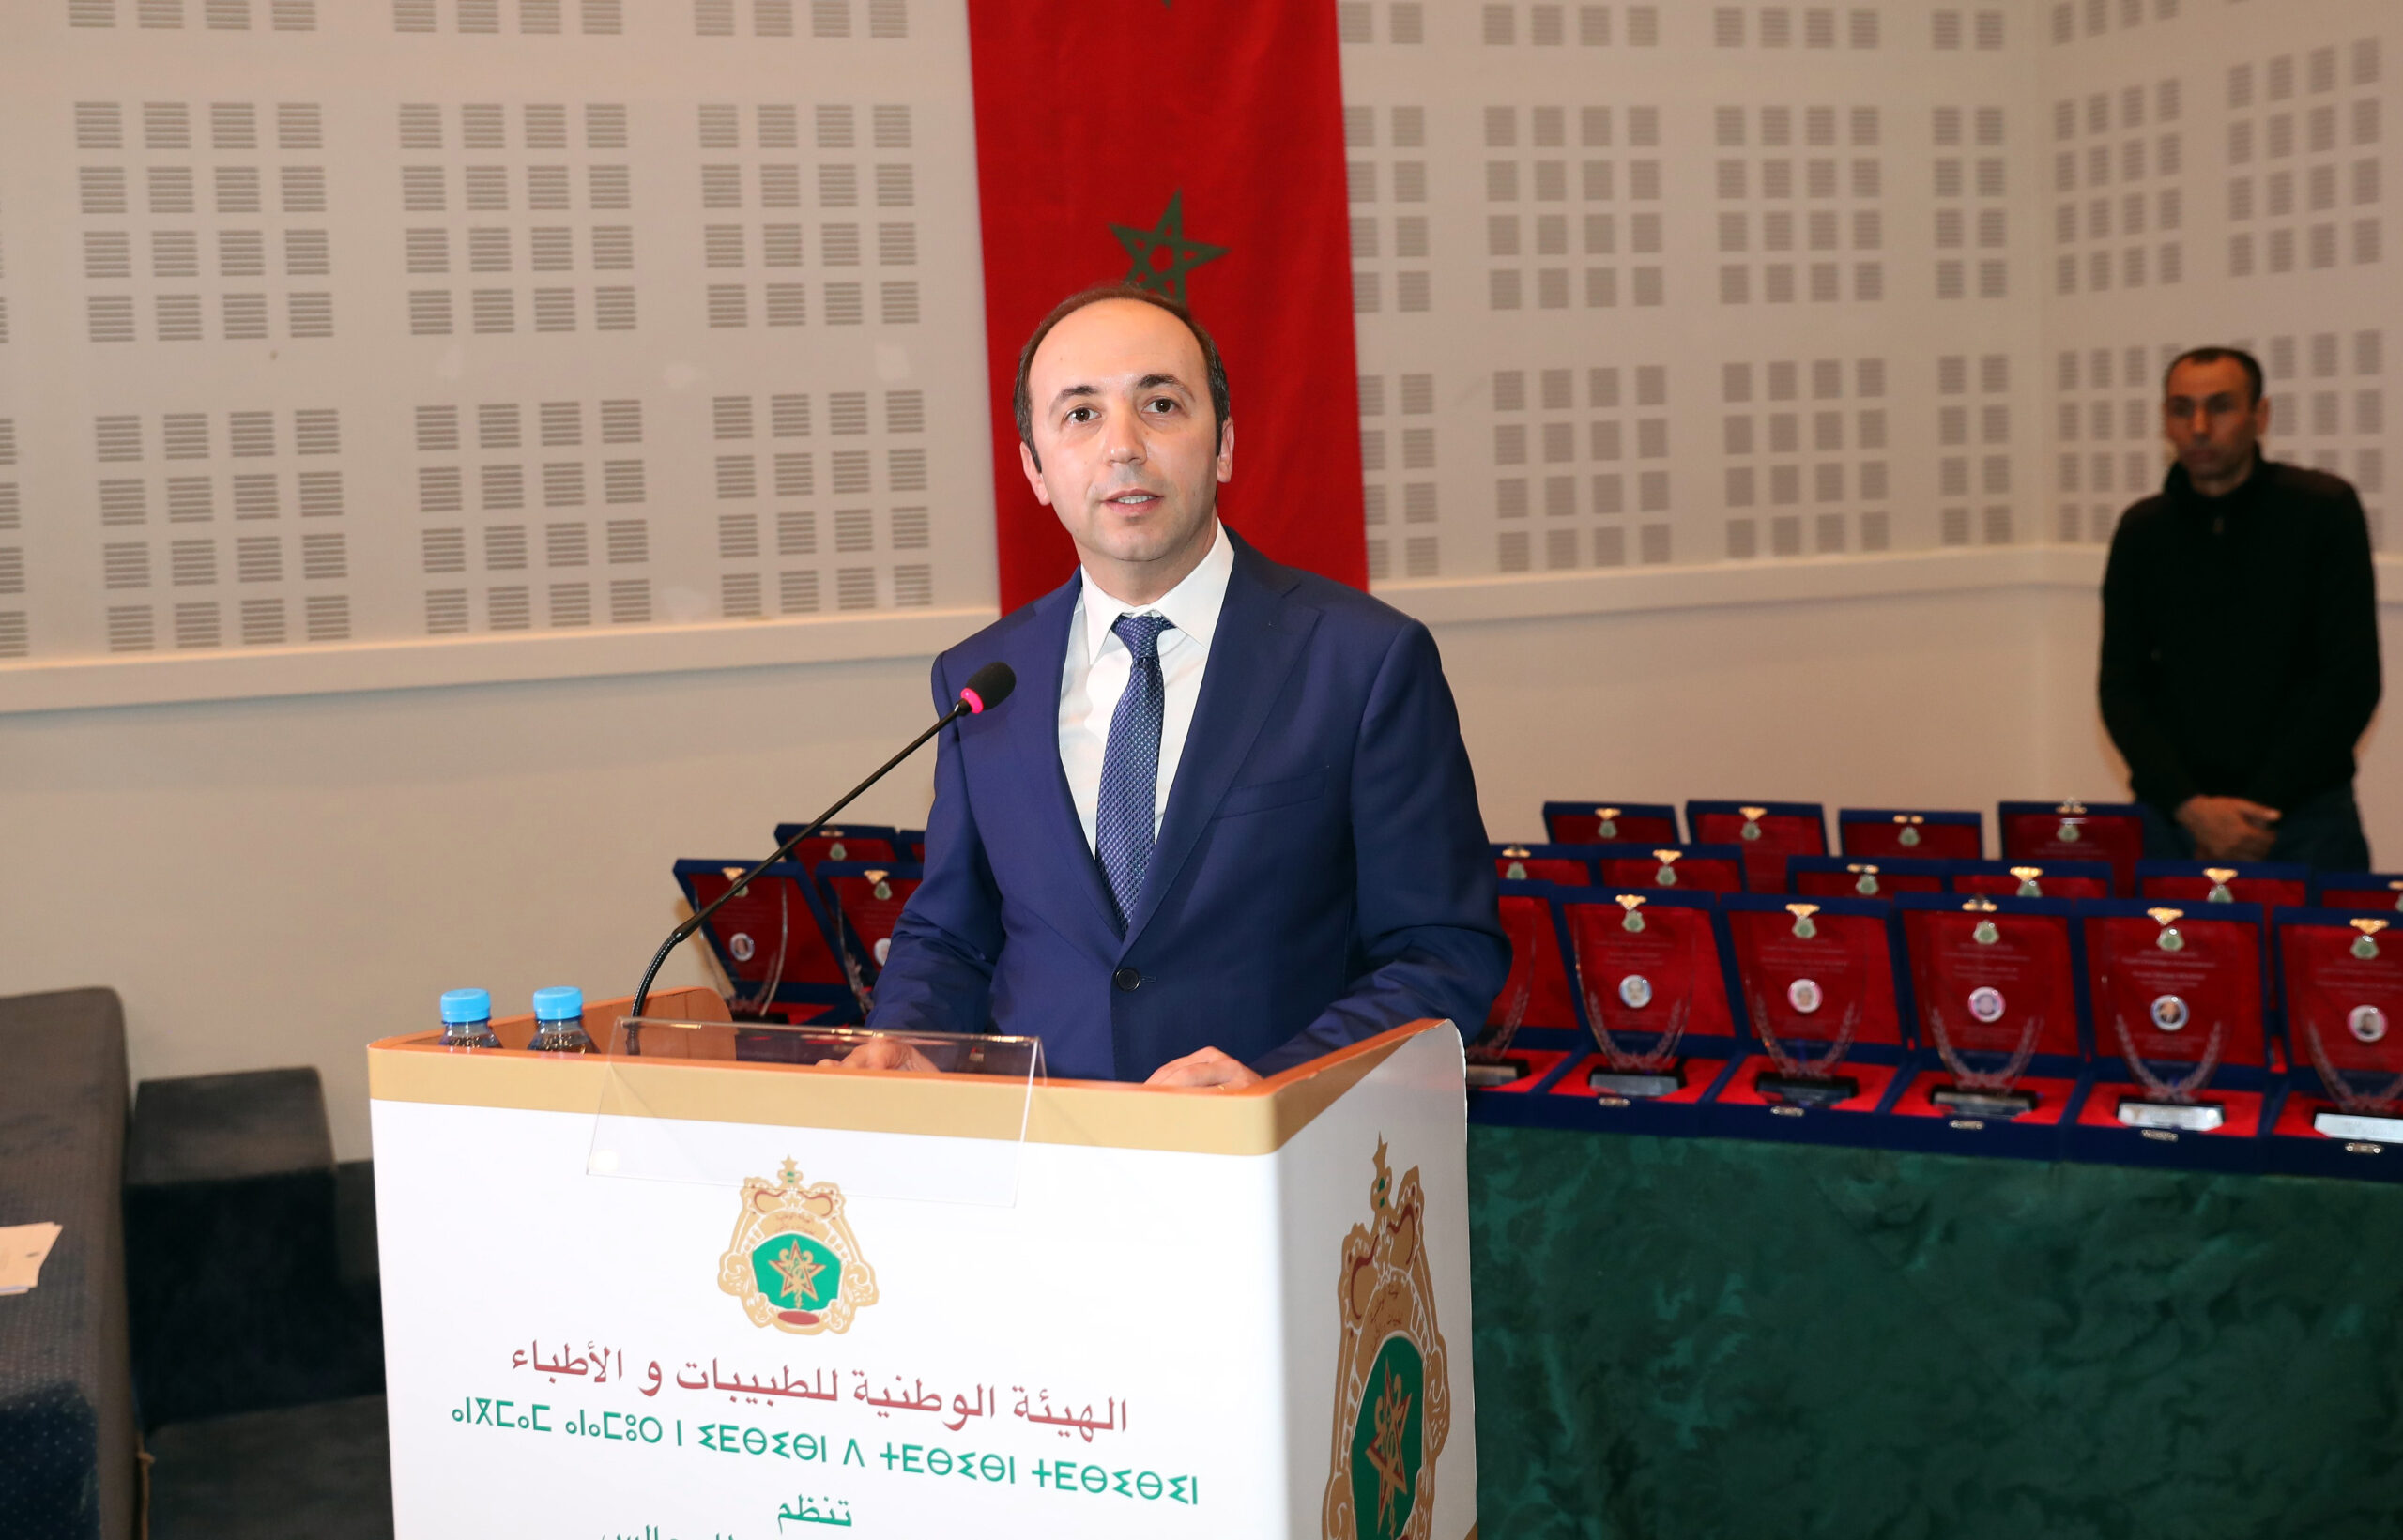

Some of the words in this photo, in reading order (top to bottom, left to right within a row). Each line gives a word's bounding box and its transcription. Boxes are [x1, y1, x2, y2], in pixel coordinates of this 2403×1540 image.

[512, 1339, 623, 1384] الأطباء
[638, 1359, 663, 1397] و
[675, 1357, 838, 1408] للطبيبات
[851, 1369, 996, 1432] الوطنية
[1011, 1385, 1128, 1443] الهيئة
[777, 1493, 853, 1535] تنظم
